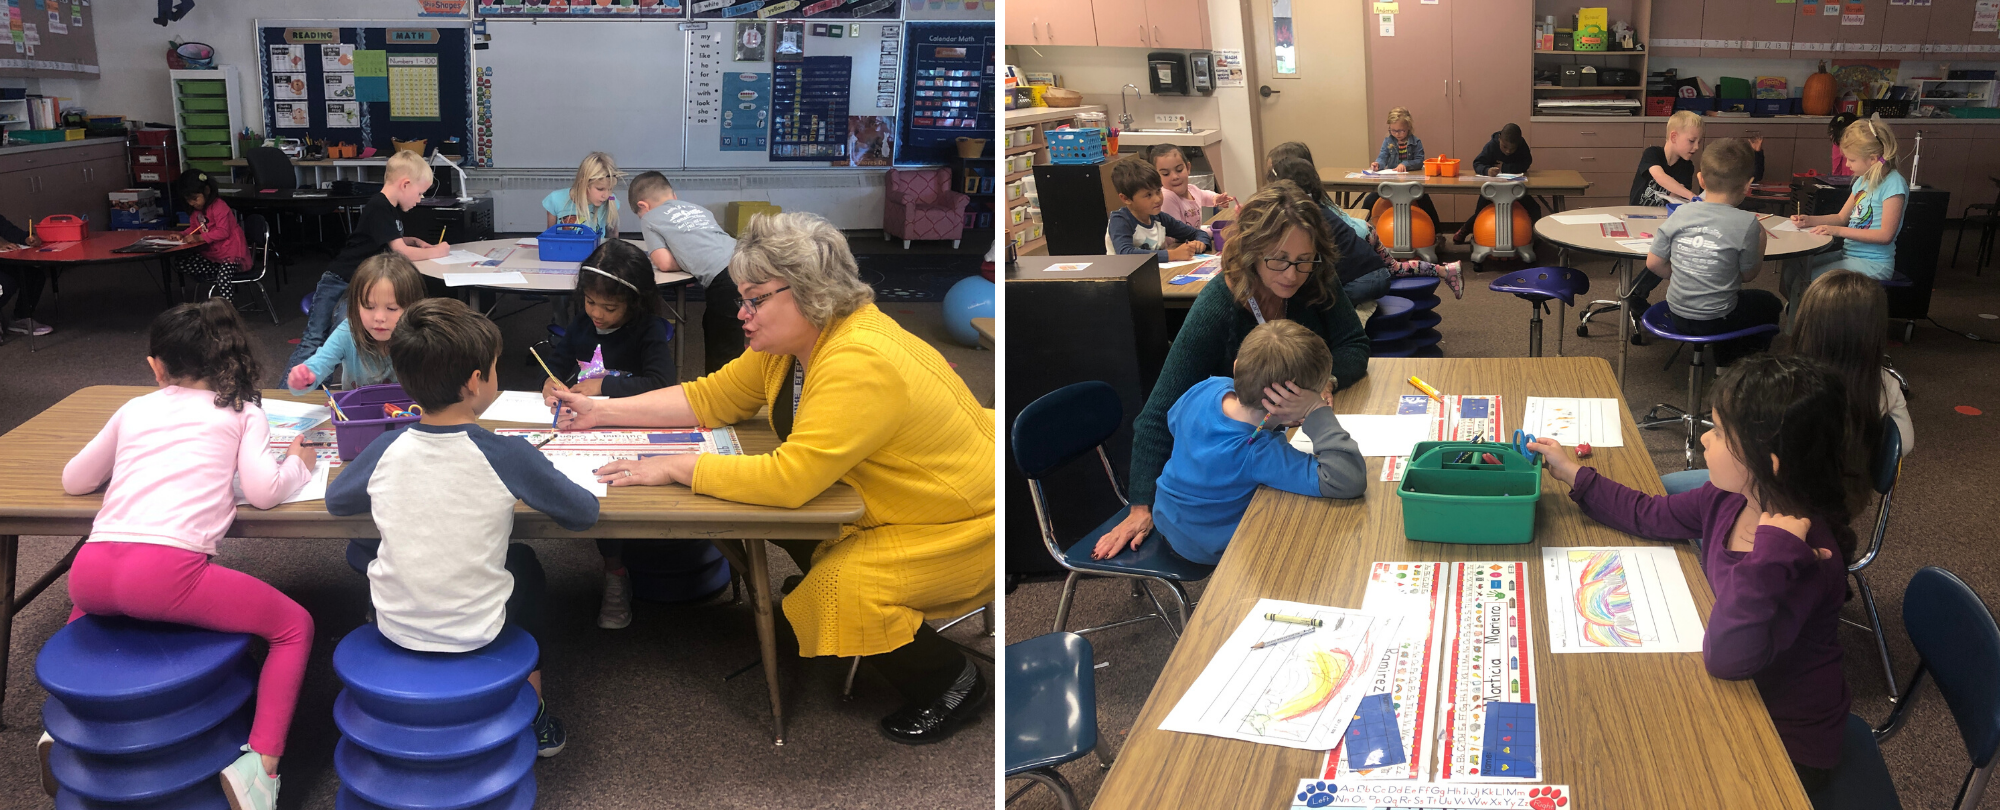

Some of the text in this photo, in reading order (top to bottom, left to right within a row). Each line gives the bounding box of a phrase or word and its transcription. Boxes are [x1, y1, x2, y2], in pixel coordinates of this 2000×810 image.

[436, 1, 461, 10] Shapes
[768, 5, 786, 14] yellow
[1843, 15, 1864, 24] Monday
[1680, 87, 1695, 98] 19
[1373, 649, 1399, 692] Ramirez
[1456, 754, 1465, 763] Bb
[1483, 752, 1492, 775] Name:
[1456, 766, 1464, 775] Aa
[1431, 786, 1445, 799] Gg
[1470, 788, 1480, 798] Jj
[1312, 796, 1330, 805] Left
[1383, 796, 1398, 807] Qq
[1504, 798, 1515, 809] Yy
[1533, 799, 1554, 810] Right
